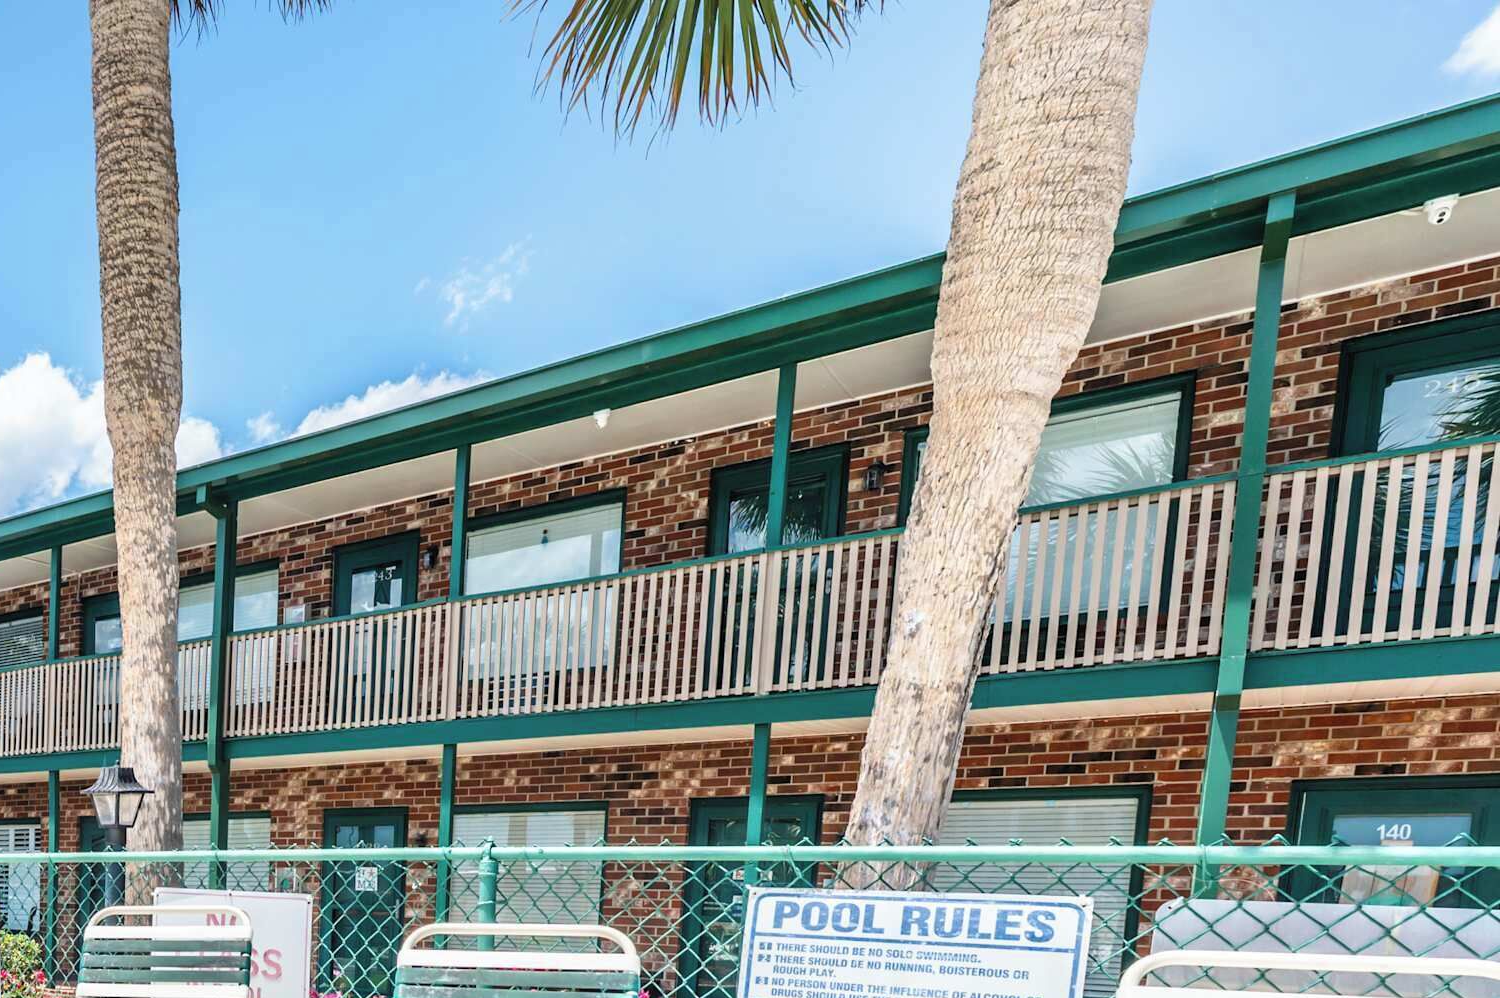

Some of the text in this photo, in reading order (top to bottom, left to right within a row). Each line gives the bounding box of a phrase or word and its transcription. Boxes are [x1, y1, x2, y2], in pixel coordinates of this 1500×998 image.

[1375, 823, 1412, 841] 140
[773, 900, 1056, 943] POOL RULES
[776, 942, 807, 952] THERE
[808, 944, 849, 955] SHOULD
[851, 946, 866, 956] BE
[867, 947, 883, 957] NO
[885, 948, 913, 959] SOLO
[772, 964, 807, 975] ROUGH
[774, 954, 805, 965] THERE
[807, 956, 848, 967] SHOULD
[850, 959, 864, 968] BE
[866, 960, 882, 970] NO
[938, 964, 1010, 979] BOISTEROUS
[1012, 969, 1029, 980] OR
[770, 987, 803, 998] DRUGS
[771, 977, 785, 986] NO
[787, 978, 827, 989] PERSON
[829, 981, 864, 992] UNDER
[867, 984, 886, 994] THE
[889, 986, 948, 998] INFLUENCE
